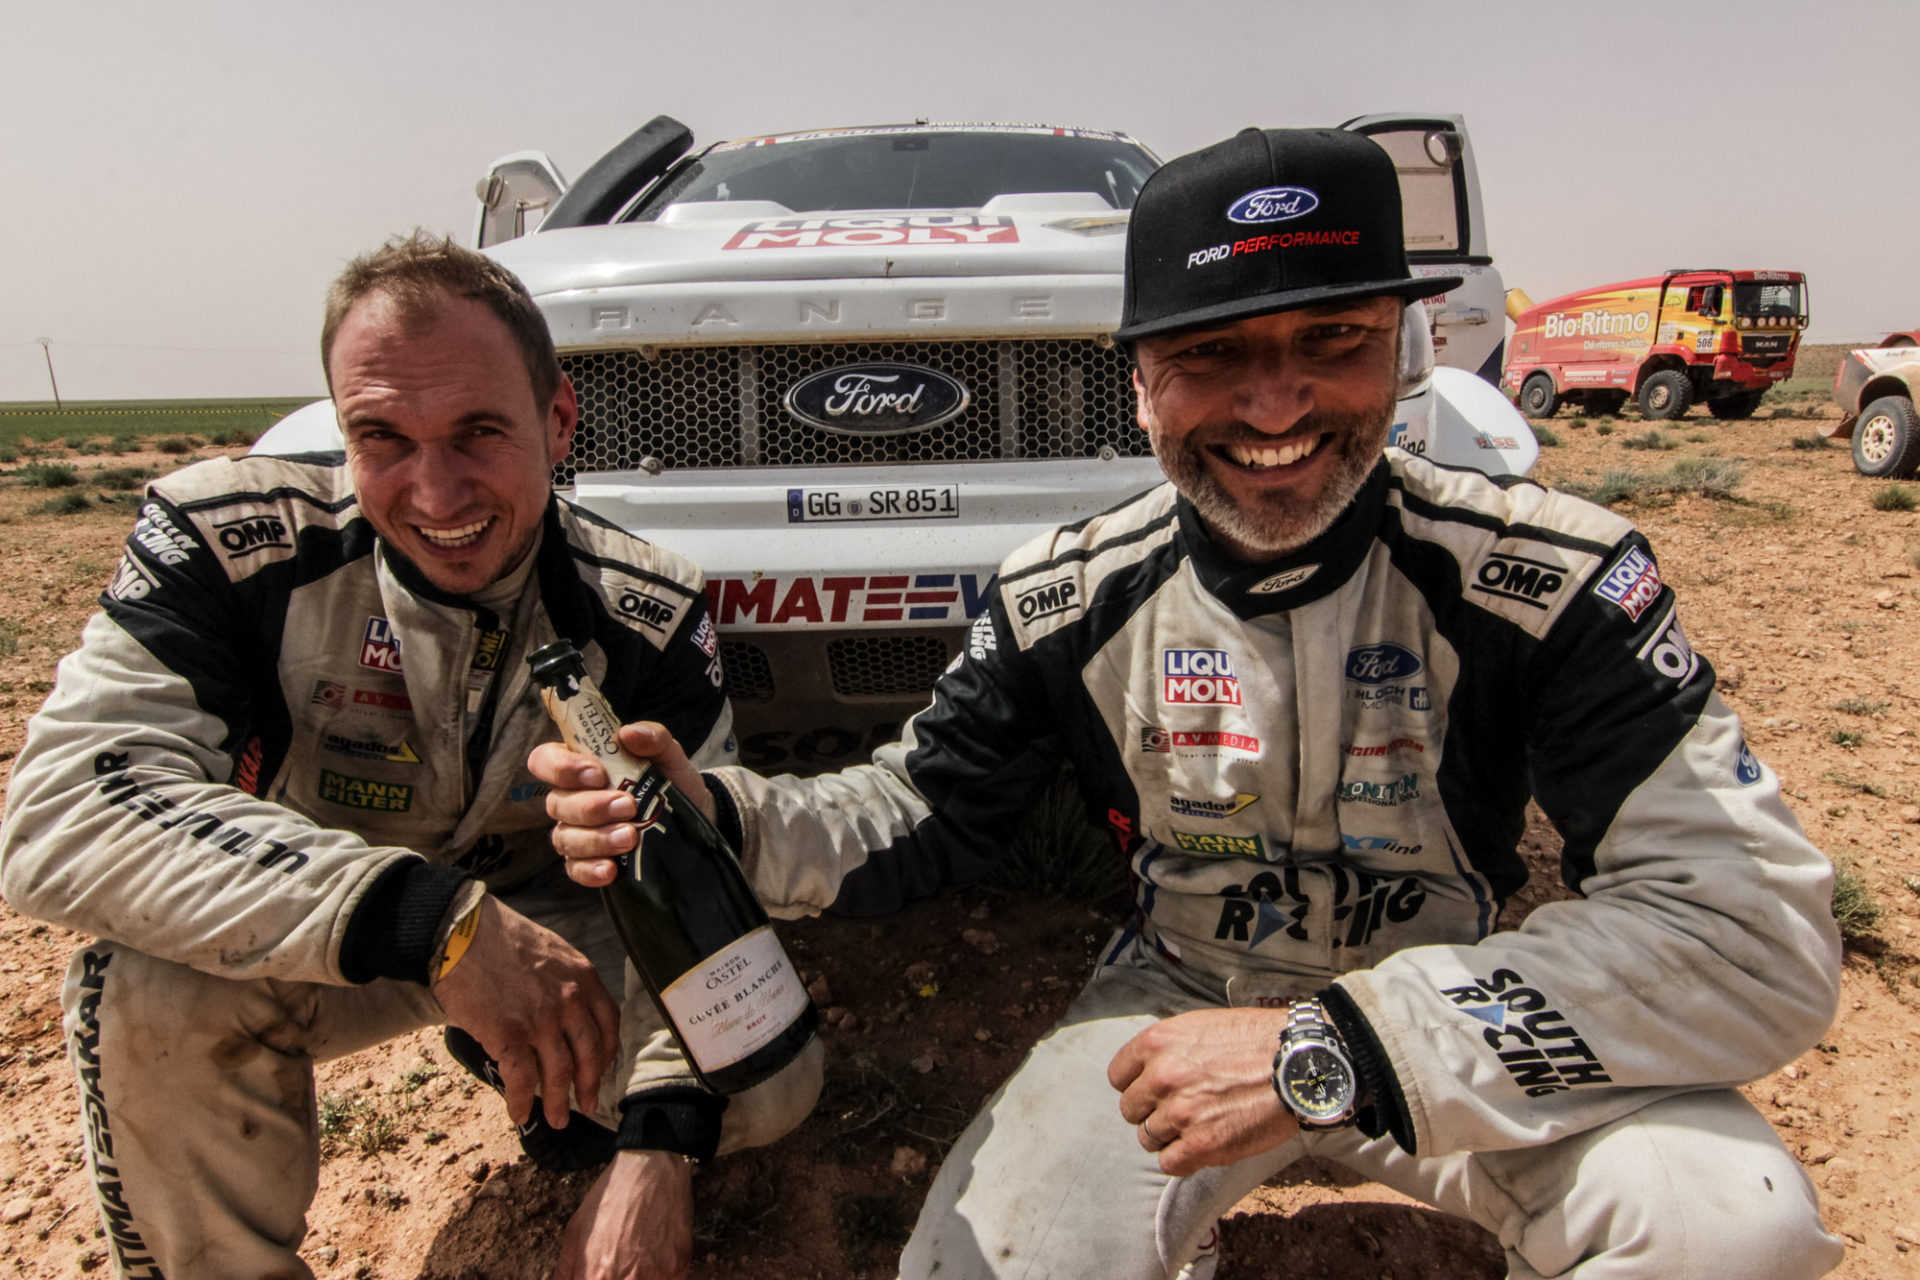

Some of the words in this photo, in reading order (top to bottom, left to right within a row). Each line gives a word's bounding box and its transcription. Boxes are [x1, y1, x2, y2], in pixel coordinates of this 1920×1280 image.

[1245, 192, 1301, 220] Ford
[738, 226, 1010, 249] MOLY
[1187, 244, 1231, 270] FORD
[1232, 231, 1361, 257] PERFORMANCE
[589, 299, 1053, 331] RANGE
[1696, 337, 1713, 349] 506
[825, 373, 925, 416] Ford
[808, 492, 841, 517] GG
[219, 518, 287, 552] OMP
[1262, 570, 1305, 592] Ford
[1478, 560, 1563, 599] OMP
[1601, 551, 1649, 600] LIQUI
[1622, 565, 1659, 613] MOLY
[619, 594, 674, 625] OMP
[1018, 582, 1076, 619] OMP
[1168, 651, 1235, 676] LIQUI
[1168, 679, 1239, 704] MOLY
[583, 698, 619, 755] CASTEL
[322, 788, 406, 810] FILTER
[324, 773, 408, 798] MANN
[1170, 795, 1237, 812] agados
[1175, 832, 1257, 851] MANN
[706, 958, 752, 990] CASTEL
[709, 955, 740, 976] MAISON
[689, 1001, 730, 1026] CUVÉE
[734, 958, 784, 1003] BLANCHE
[746, 1014, 767, 1031] BRUT
[1474, 968, 1613, 1085] SOUTH
